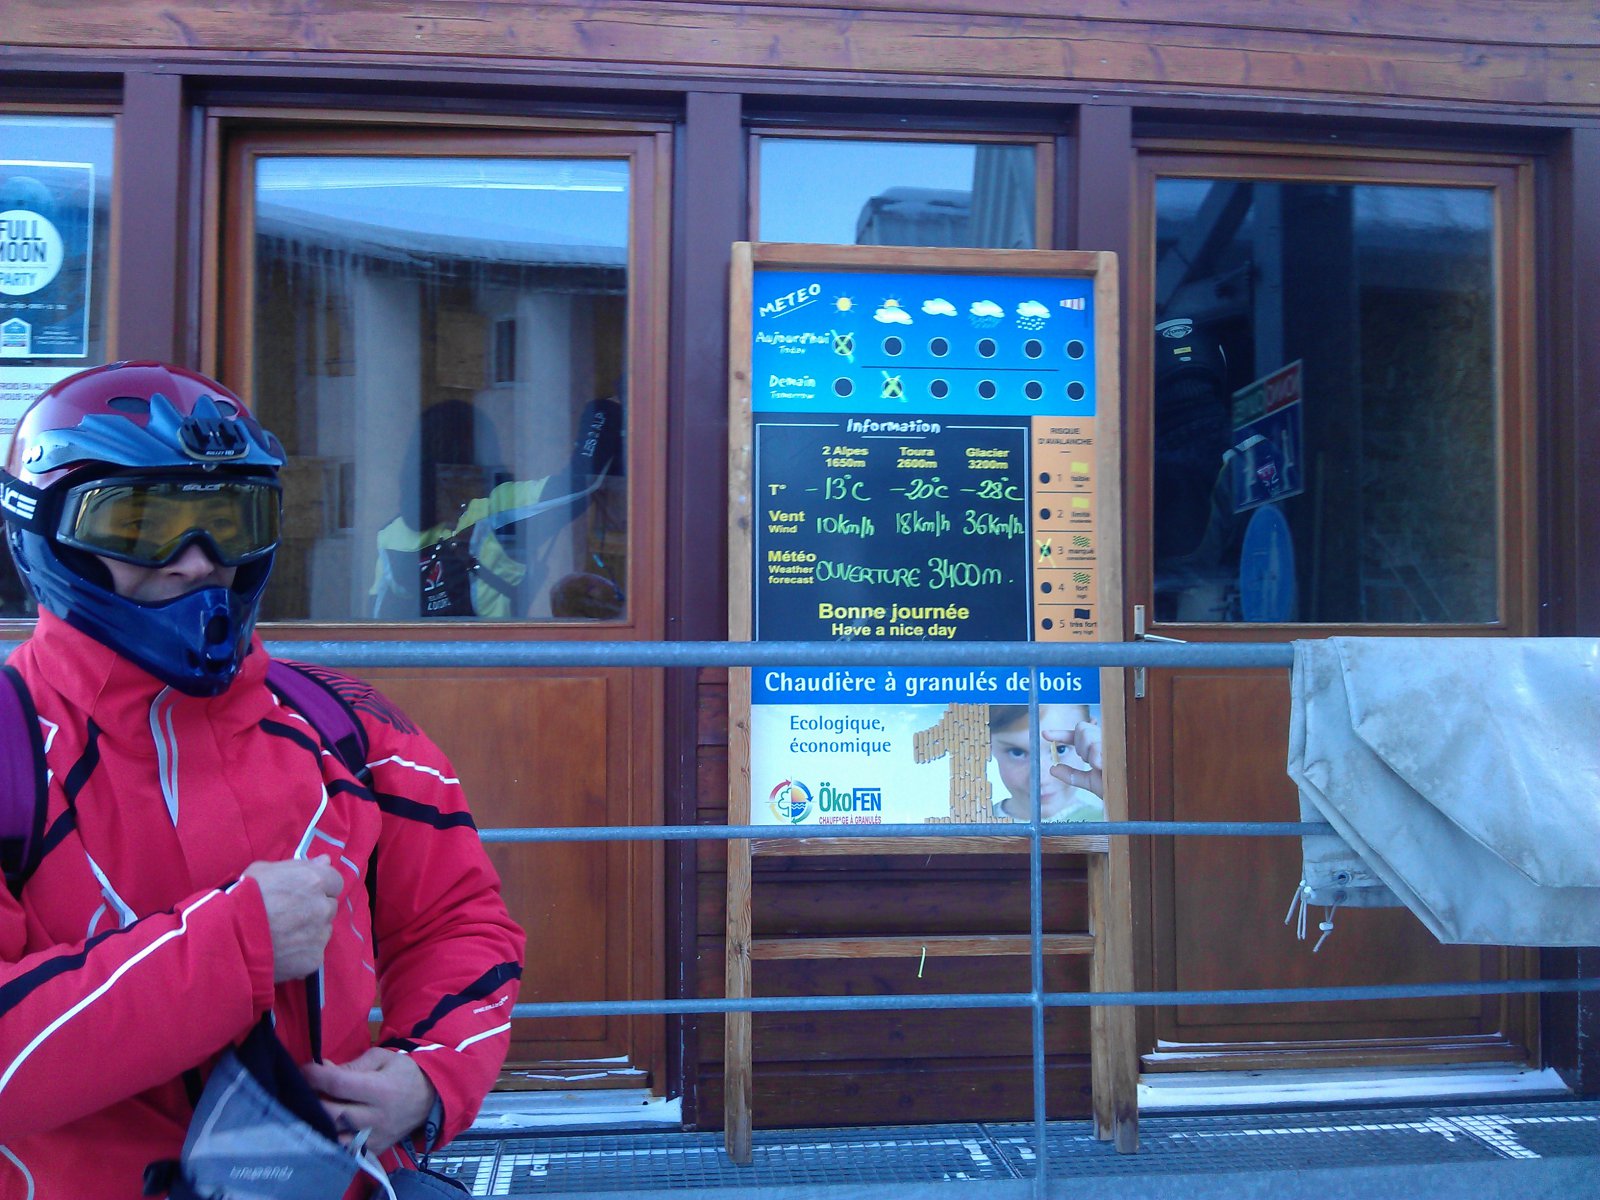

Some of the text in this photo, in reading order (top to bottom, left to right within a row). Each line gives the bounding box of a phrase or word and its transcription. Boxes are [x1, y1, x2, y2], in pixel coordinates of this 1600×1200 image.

[759, 283, 821, 317] METEO
[769, 375, 816, 387] Demain
[846, 418, 941, 434] Information
[821, 446, 869, 458] 2 Alpes
[899, 446, 935, 457] Toura
[965, 447, 1010, 459] Glacier
[825, 458, 866, 468] 1650m
[768, 510, 805, 522] Vent
[1057, 509, 1064, 519] 2
[768, 525, 798, 534] Wind
[768, 550, 817, 562] Météo
[768, 565, 815, 574] Weather
[768, 575, 814, 585] forecast
[1058, 583, 1065, 592] 4
[818, 603, 970, 623] Bonne journée
[1059, 619, 1065, 629] 5
[831, 623, 957, 640] Have a nice day
[764, 671, 1083, 697] Chaudière à granulés de bois
[790, 715, 885, 735] Ecologique,
[789, 737, 892, 757] économique
